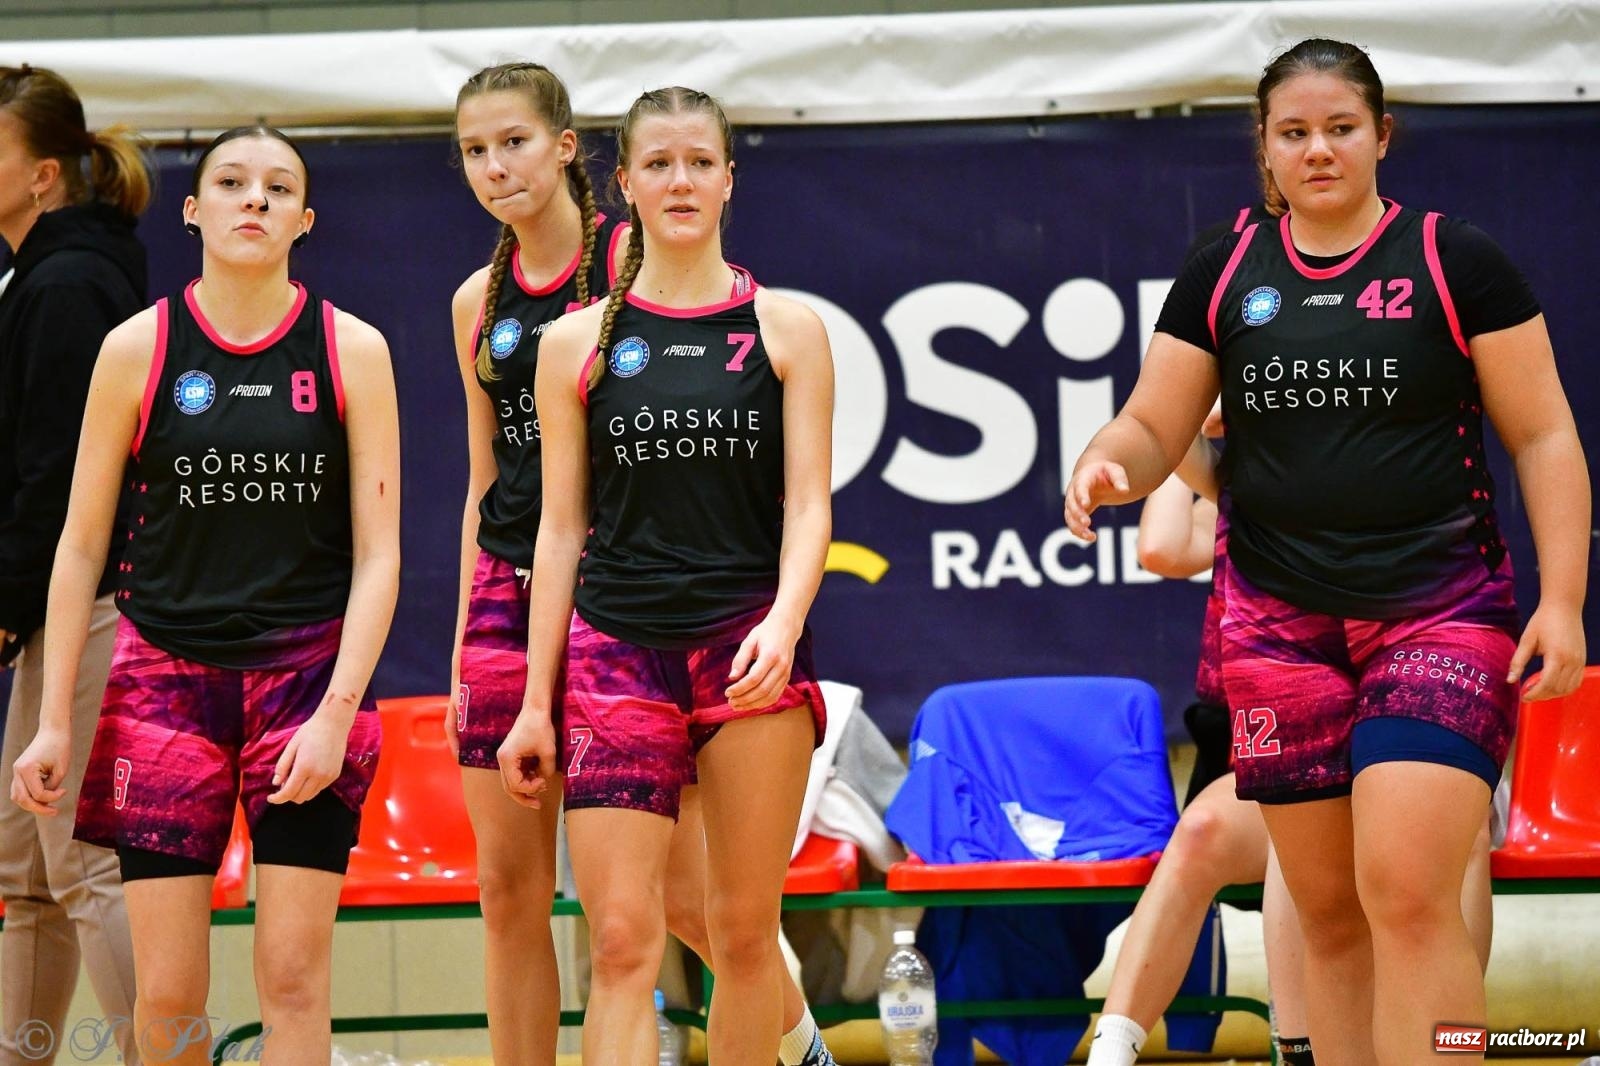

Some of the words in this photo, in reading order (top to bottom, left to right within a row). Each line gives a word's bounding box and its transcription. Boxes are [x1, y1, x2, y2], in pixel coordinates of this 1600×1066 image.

[1308, 294, 1344, 306] PROTON
[1357, 279, 1412, 318] 42
[669, 345, 706, 356] PROTON
[726, 333, 756, 371] 7
[235, 385, 272, 396] PROTON
[291, 370, 317, 413] 8
[1246, 388, 1398, 413] RESORTY
[613, 437, 759, 467] RESORTY
[180, 482, 321, 508] RESORTY
[1388, 663, 1483, 696] RESORTY
[1233, 708, 1281, 758] 42
[568, 728, 593, 777] 7
[114, 757, 132, 810] 8
